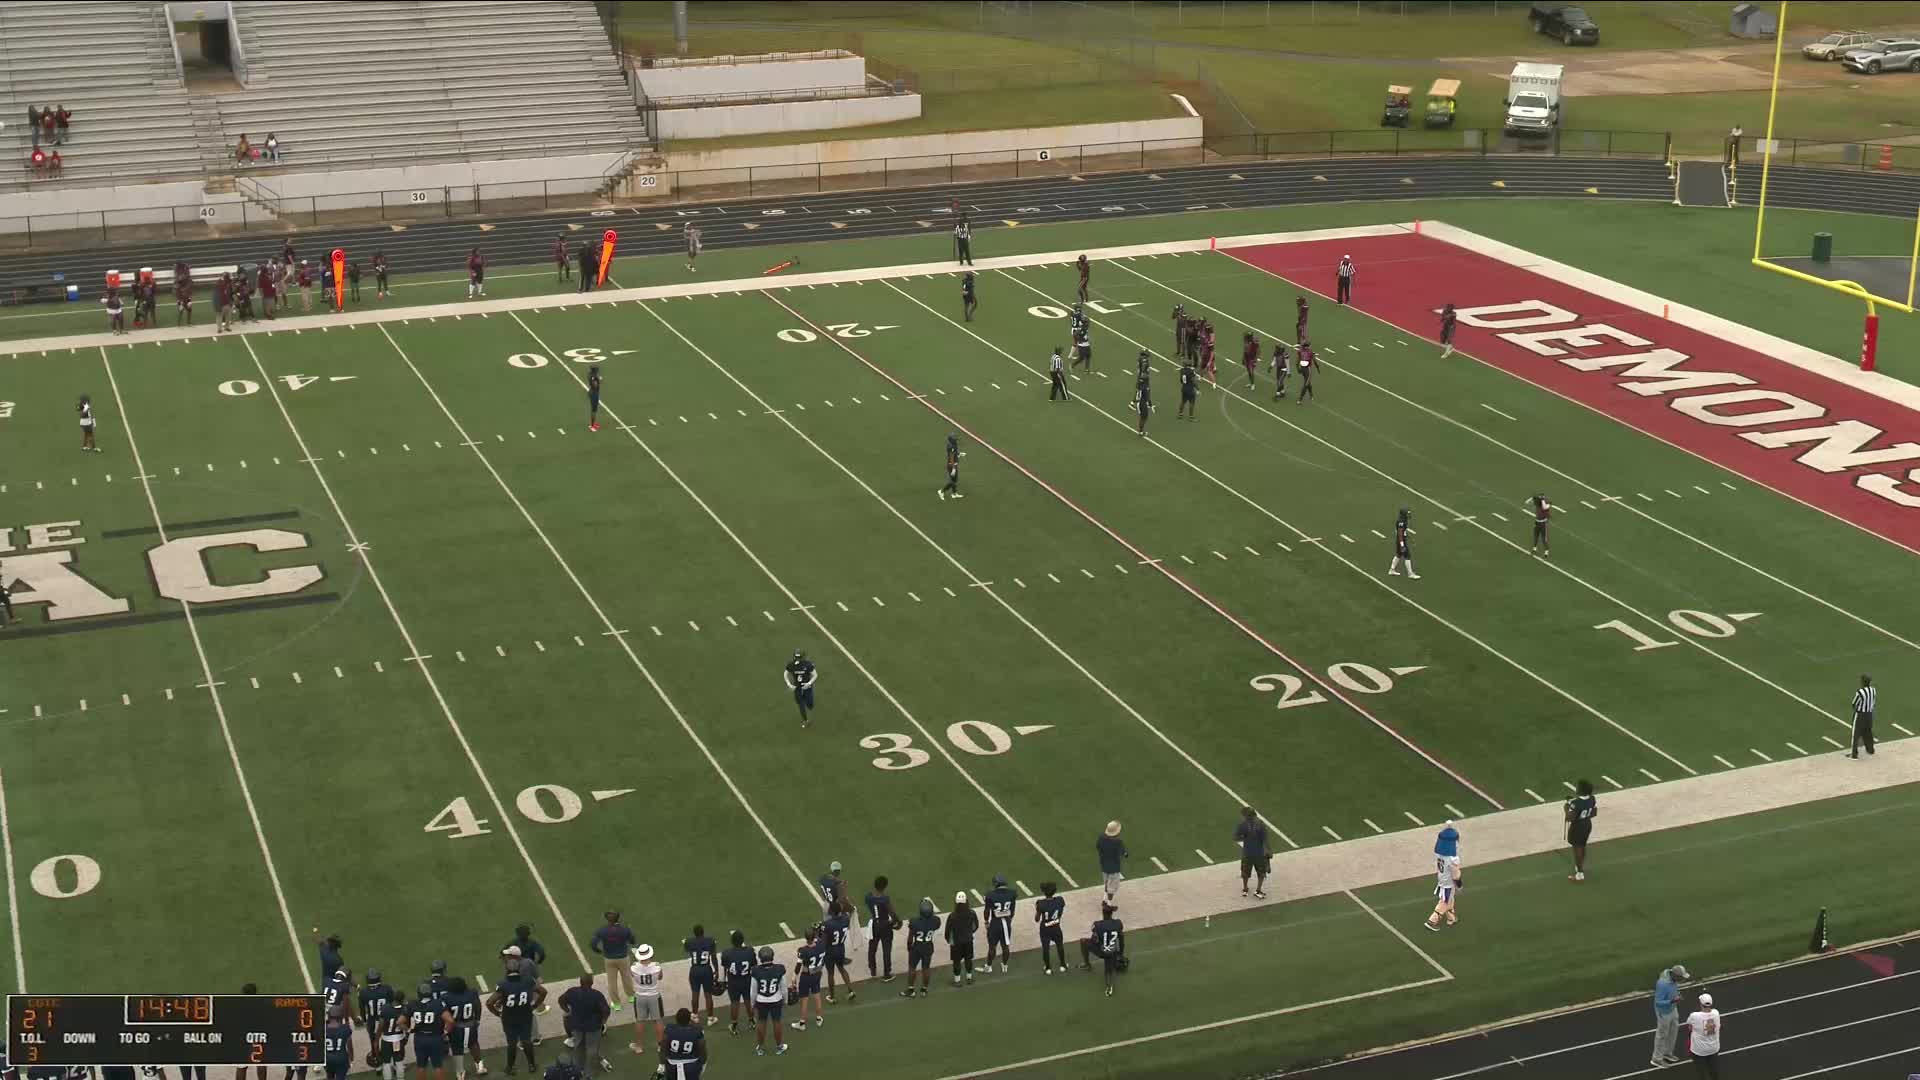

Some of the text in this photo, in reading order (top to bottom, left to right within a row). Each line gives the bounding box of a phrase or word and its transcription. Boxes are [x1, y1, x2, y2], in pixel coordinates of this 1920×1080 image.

[1039, 150, 1049, 160] G
[641, 176, 656, 186] 20
[411, 192, 427, 202] 30
[200, 207, 216, 217] 40
[1593, 608, 1737, 652] 10
[1249, 661, 1394, 710] 20
[859, 719, 1013, 770] 30
[423, 783, 584, 839] 40
[30, 853, 102, 898] 0
[1103, 931, 1118, 946] 12
[729, 961, 750, 976] 42
[669, 1038, 694, 1054] 99
